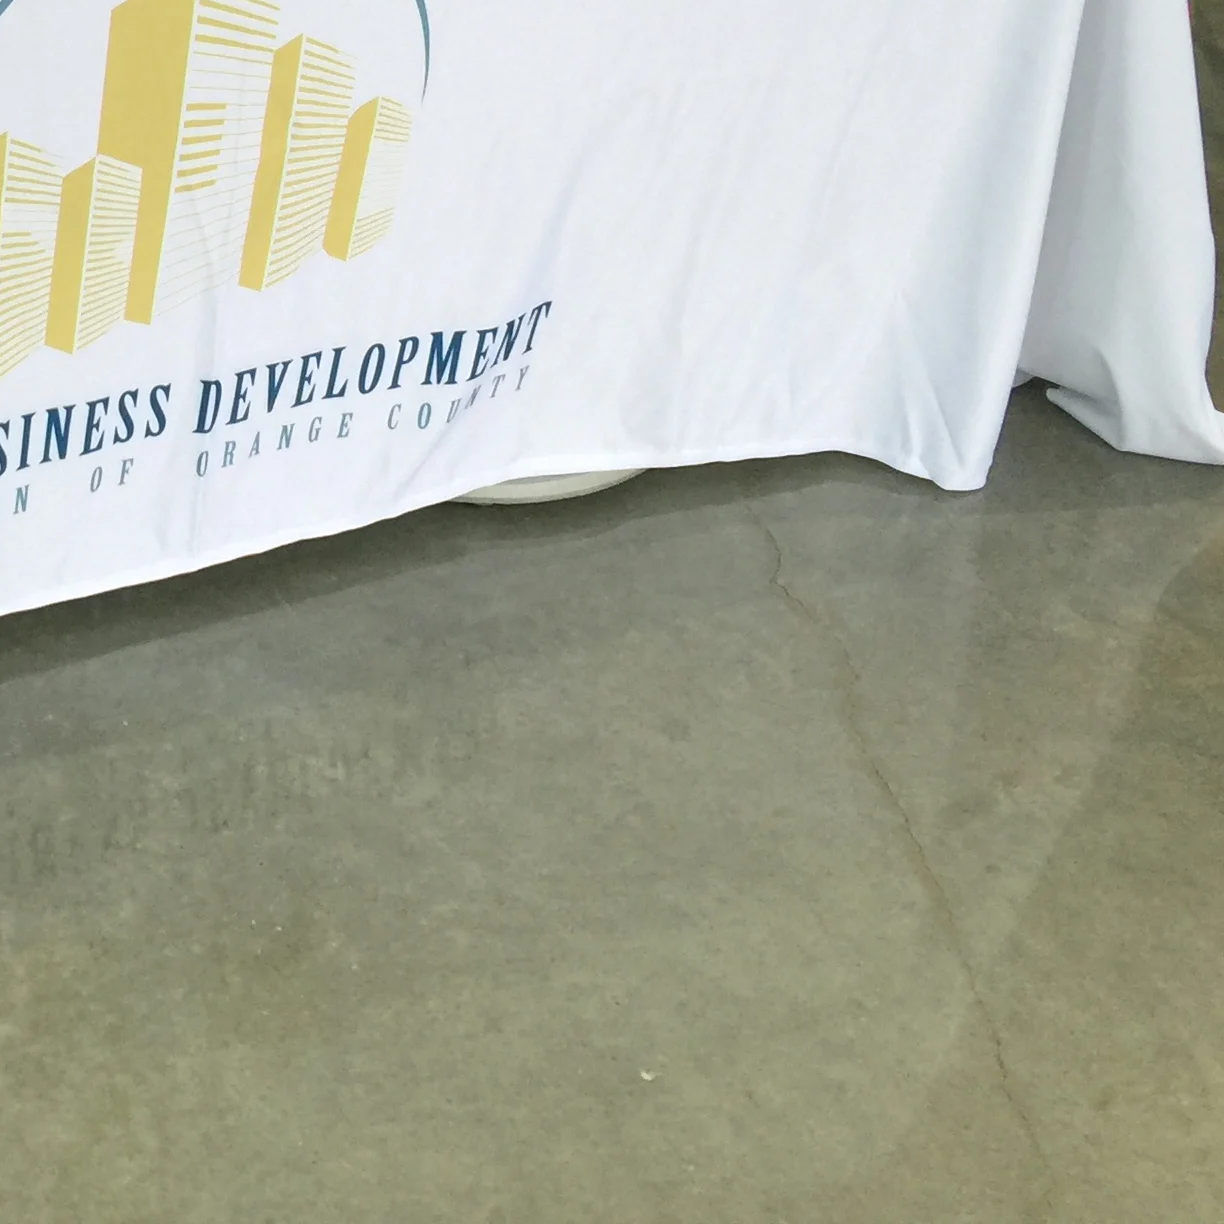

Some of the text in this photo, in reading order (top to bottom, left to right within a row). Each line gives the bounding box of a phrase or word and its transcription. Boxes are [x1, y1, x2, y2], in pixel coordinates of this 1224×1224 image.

[89, 457, 135, 493] OF
[195, 412, 354, 478] ORANGE
[386, 365, 531, 431] COUNTY
[192, 301, 553, 435] DEVELOPMENT
